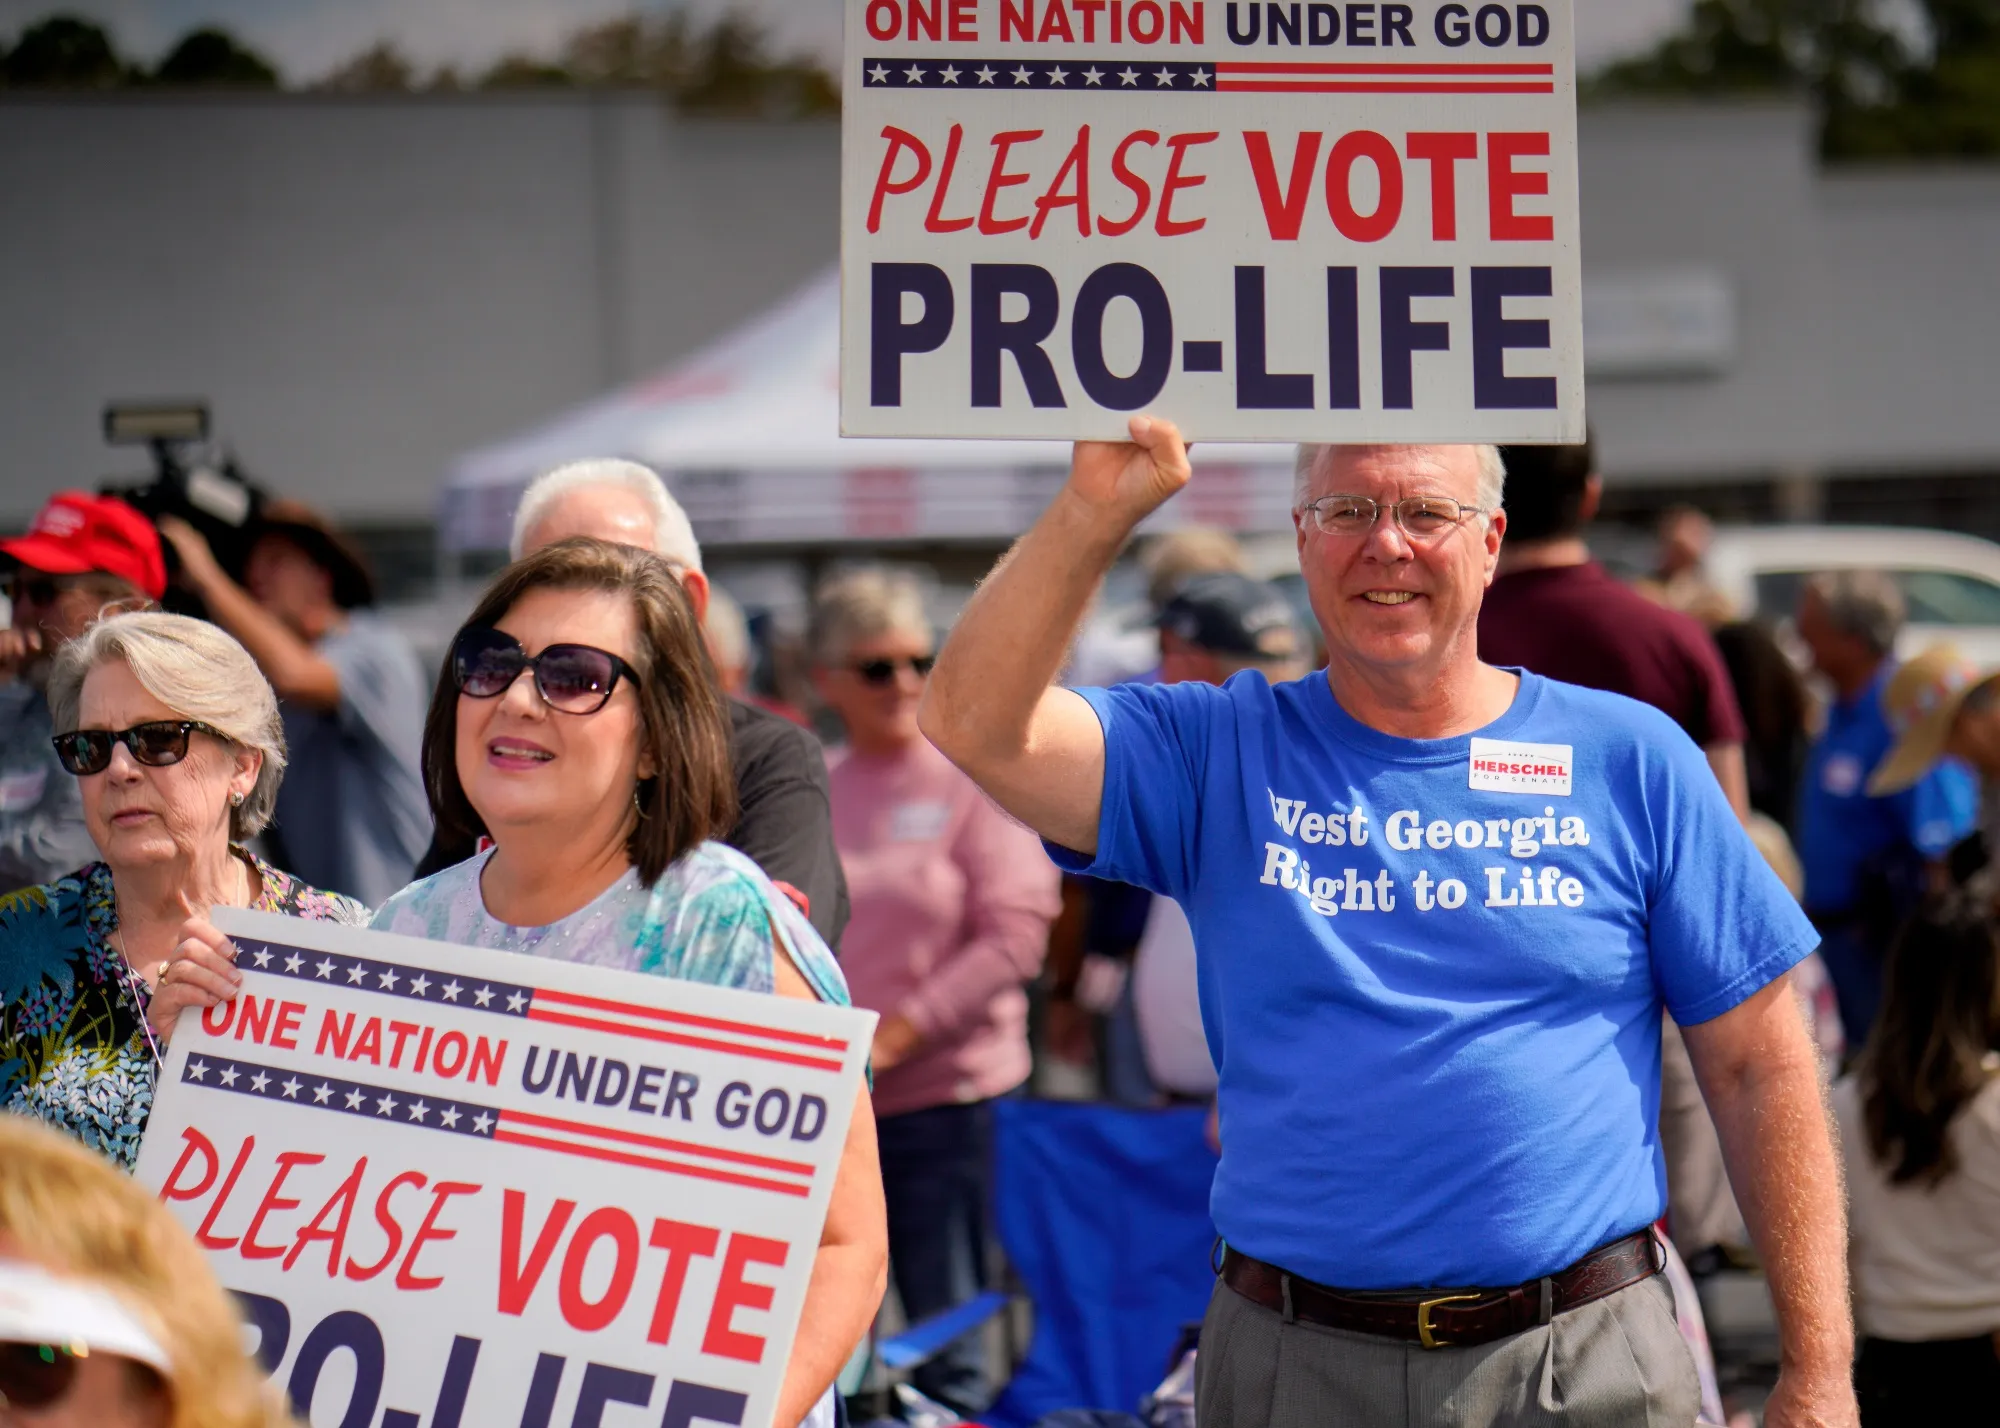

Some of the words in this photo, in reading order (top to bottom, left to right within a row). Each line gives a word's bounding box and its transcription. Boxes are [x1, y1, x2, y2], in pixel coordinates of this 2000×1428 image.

[865, 0, 978, 43] ONE
[1000, 0, 1205, 45] NATION
[1226, 3, 1416, 47] UNDER
[1434, 4, 1550, 47] GOD
[866, 123, 1220, 239] PLEASE
[1243, 130, 1554, 242] VOTE
[870, 262, 1558, 411] PRO-LIFE
[1473, 759, 1568, 776] HERSCHEL
[1473, 773, 1500, 781] FOR
[1511, 776, 1568, 785] SENATE
[1267, 786, 1369, 847] West
[1385, 806, 1590, 858] Georgia
[1259, 842, 1396, 917] Right
[1412, 869, 1467, 912] to
[1484, 866, 1585, 908] Life
[201, 994, 307, 1050] ONE
[314, 1009, 508, 1087] NATION
[521, 1044, 699, 1122] UNDER
[714, 1080, 828, 1143] GOD
[158, 1126, 482, 1291] PLEASE
[497, 1188, 790, 1365] VOTE
[225, 1287, 749, 1428] O-LIF
